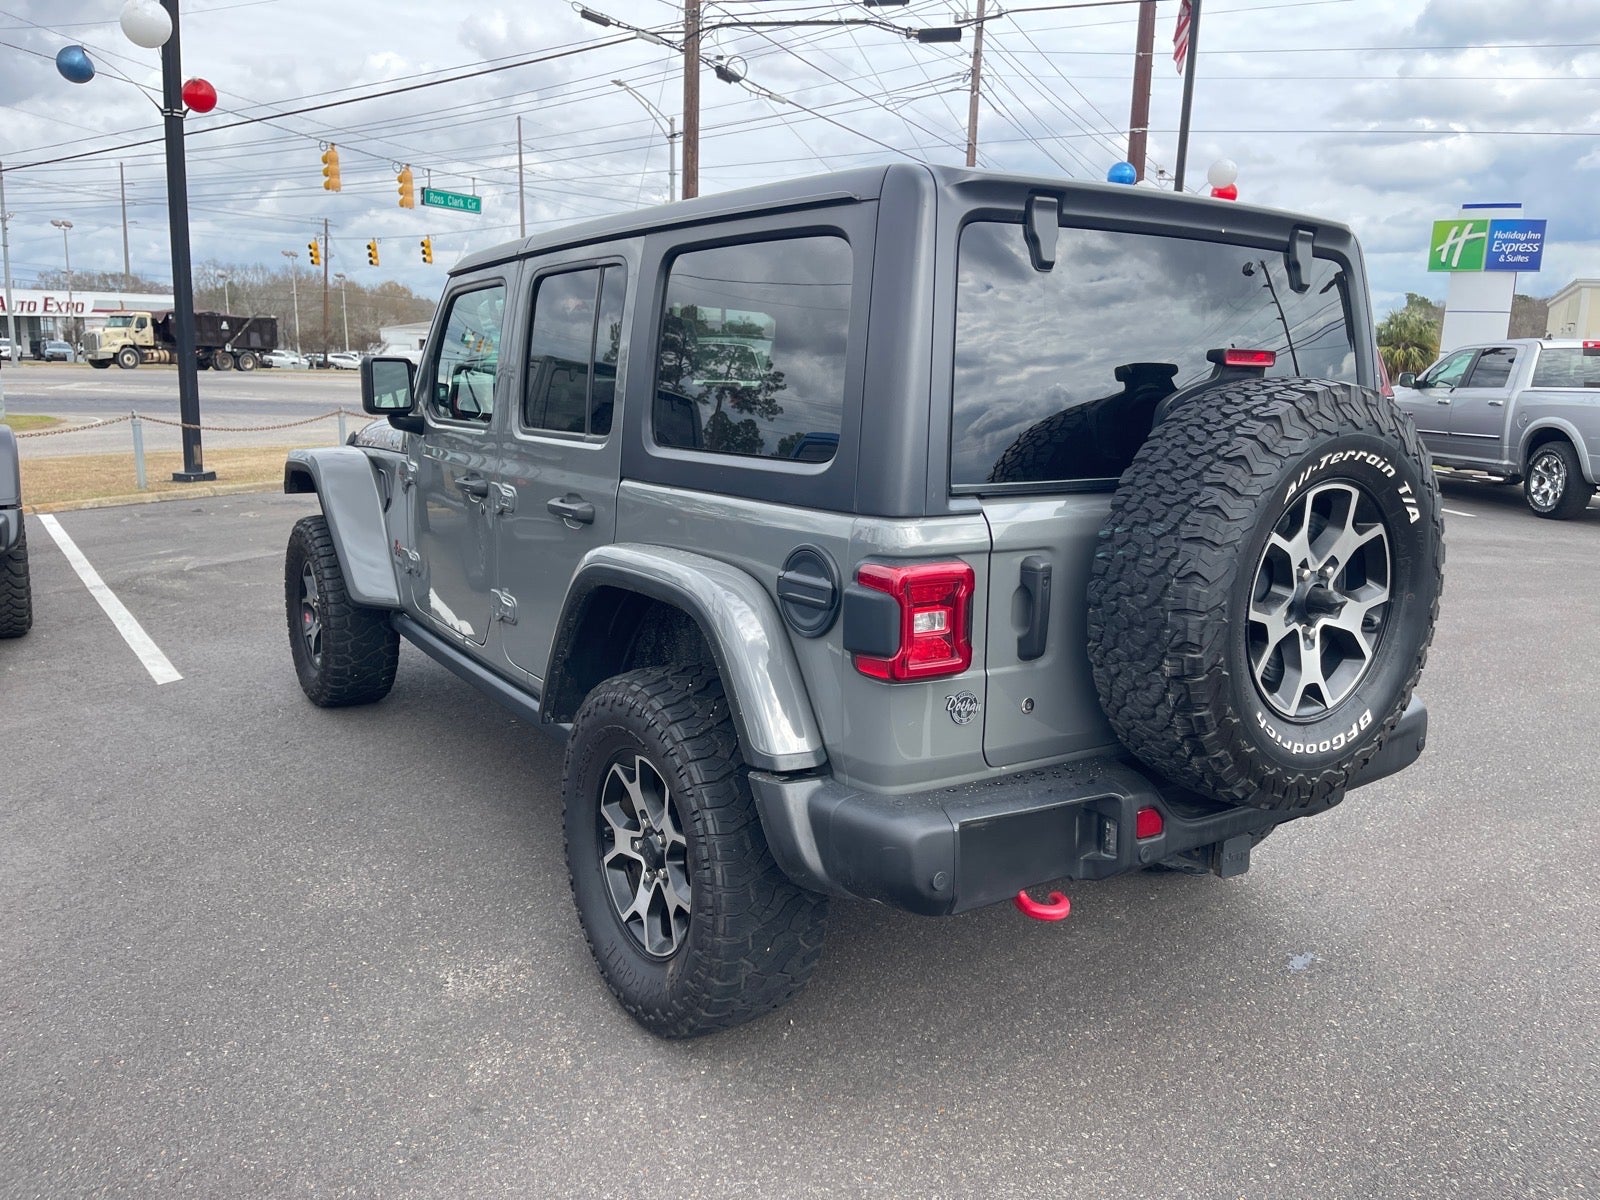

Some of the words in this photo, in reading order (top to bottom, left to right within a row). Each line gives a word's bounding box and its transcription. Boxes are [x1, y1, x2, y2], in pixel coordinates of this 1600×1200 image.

[429, 192, 445, 205] Ross
[447, 195, 464, 208] Clark
[467, 199, 477, 210] Cir
[1494, 230, 1526, 242] Holiday
[1526, 230, 1542, 240] Inn
[1492, 241, 1540, 254] Express
[1499, 254, 1505, 262] &
[1506, 254, 1530, 263] Suites
[1284, 449, 1396, 504] All-Terrain
[945, 695, 981, 712] Dothan
[1255, 708, 1373, 755] BFGoodrich
